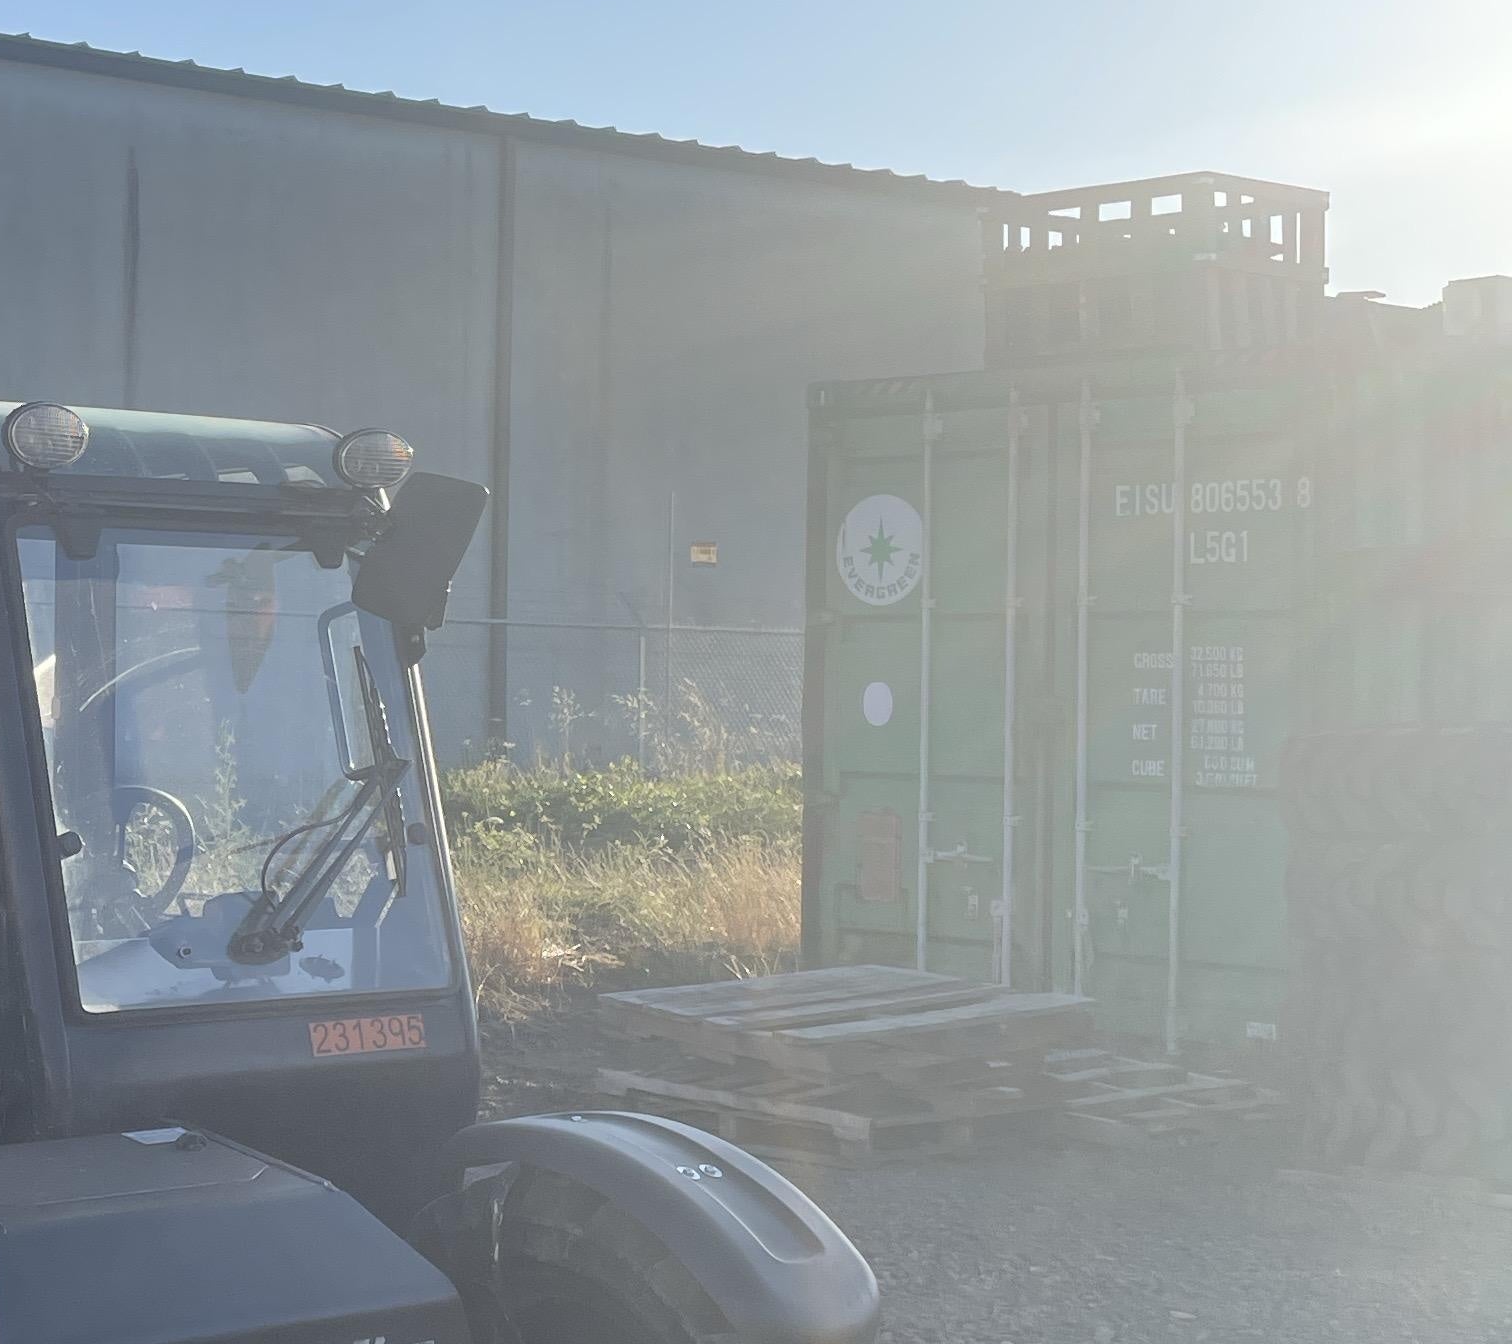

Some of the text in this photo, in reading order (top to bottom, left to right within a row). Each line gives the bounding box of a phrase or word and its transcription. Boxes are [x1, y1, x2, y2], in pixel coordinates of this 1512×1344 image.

[1114, 475, 1312, 517] EISU 806553 8
[1189, 529, 1249, 565] L5G1
[841, 552, 921, 601] EVERGREEN
[1133, 651, 1176, 669] GROSS
[1132, 687, 1168, 706] TARE
[1131, 723, 1159, 741] NET
[1131, 758, 1167, 777] CUBE
[312, 1015, 424, 1055] 231395
